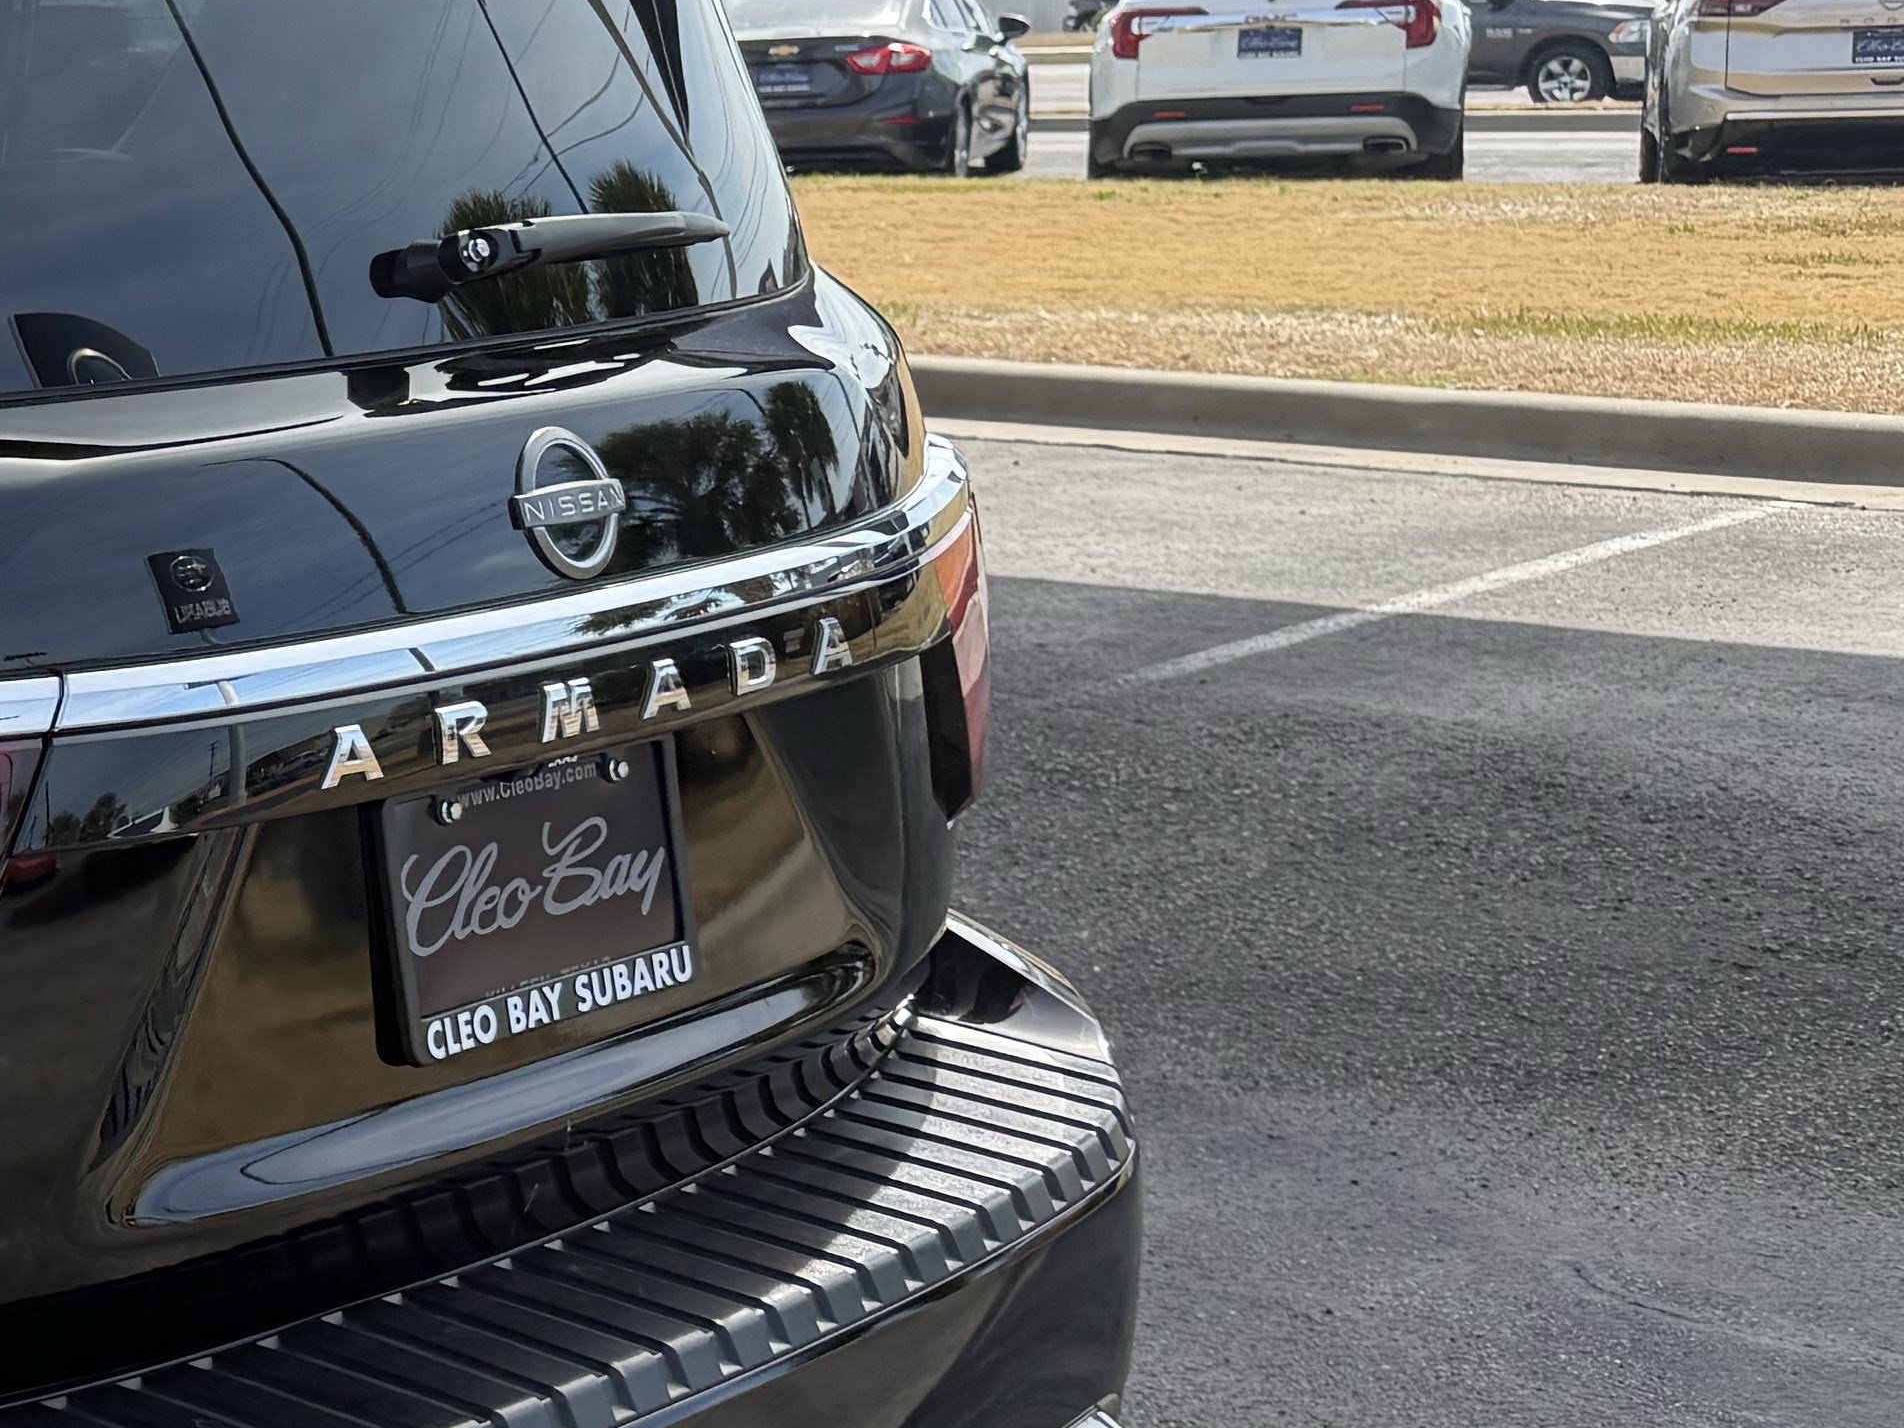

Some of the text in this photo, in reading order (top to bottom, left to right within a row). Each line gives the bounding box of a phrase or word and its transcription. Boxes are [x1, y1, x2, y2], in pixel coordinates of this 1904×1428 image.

[524, 485, 624, 522] NISSAN
[321, 618, 854, 789] ARMADA
[457, 762, 597, 808] www.CleoBay.com
[400, 816, 666, 957] Cleo Bay
[426, 1004, 498, 1060] CLEO
[507, 982, 562, 1034] BAY
[575, 944, 692, 1012] SUBARU
